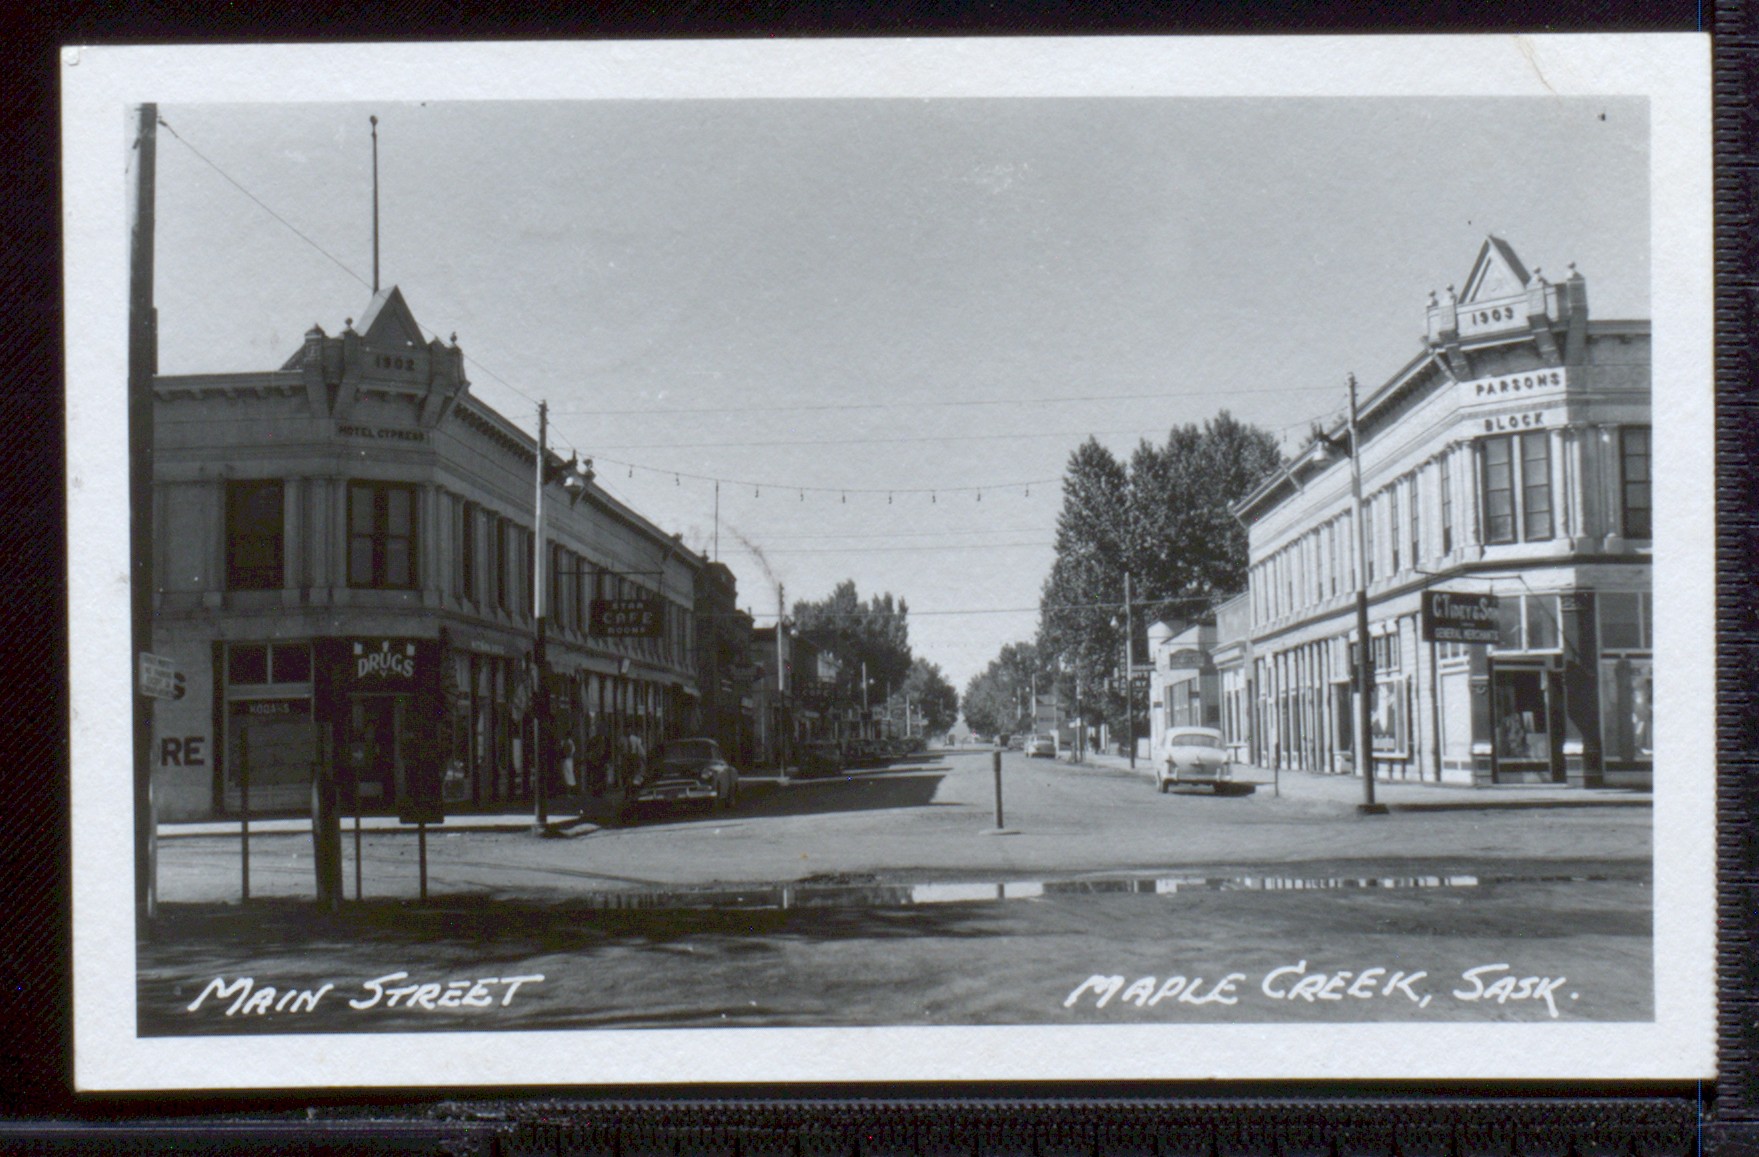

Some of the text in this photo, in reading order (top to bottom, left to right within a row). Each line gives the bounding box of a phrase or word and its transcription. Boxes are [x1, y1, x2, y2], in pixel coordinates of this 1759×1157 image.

[1472, 306, 1514, 326] 1903
[1476, 372, 1560, 396] PARSONS
[1484, 412, 1544, 432] BLOCK
[603, 611, 652, 624] CAFE
[358, 652, 414, 678] DRUGS
